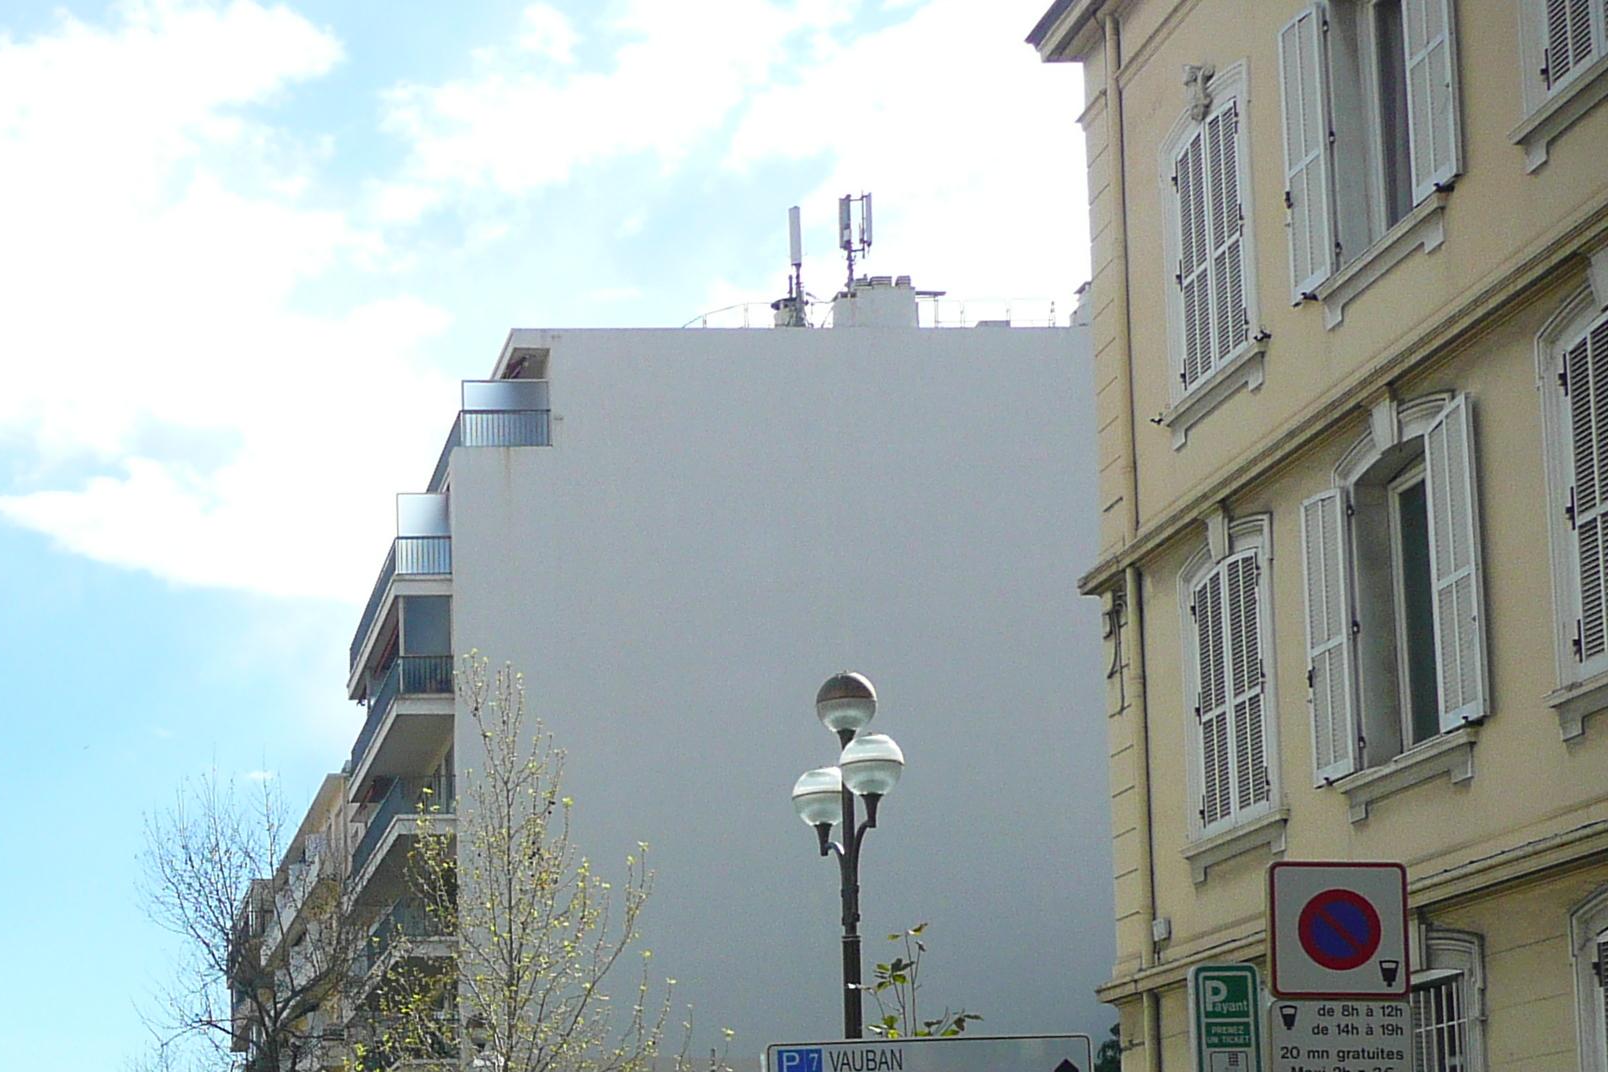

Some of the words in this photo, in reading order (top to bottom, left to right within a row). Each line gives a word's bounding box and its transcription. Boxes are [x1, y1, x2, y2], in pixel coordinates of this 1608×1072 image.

[1205, 980, 1249, 1013] Payant
[1317, 1005, 1335, 1017] de
[1341, 1005, 1359, 1017] 8h
[1365, 1004, 1374, 1017] à
[1380, 1005, 1403, 1017] 12h
[1312, 1023, 1329, 1035] de
[1336, 1023, 1359, 1035] 14h
[1365, 1023, 1374, 1036] à
[1380, 1024, 1403, 1036] 19h
[809, 1054, 819, 1072] 7
[829, 1049, 903, 1072] VAUBAN
[1280, 1046, 1300, 1059] 20
[1307, 1049, 1330, 1059] mn
[1337, 1047, 1404, 1062] gratuites
